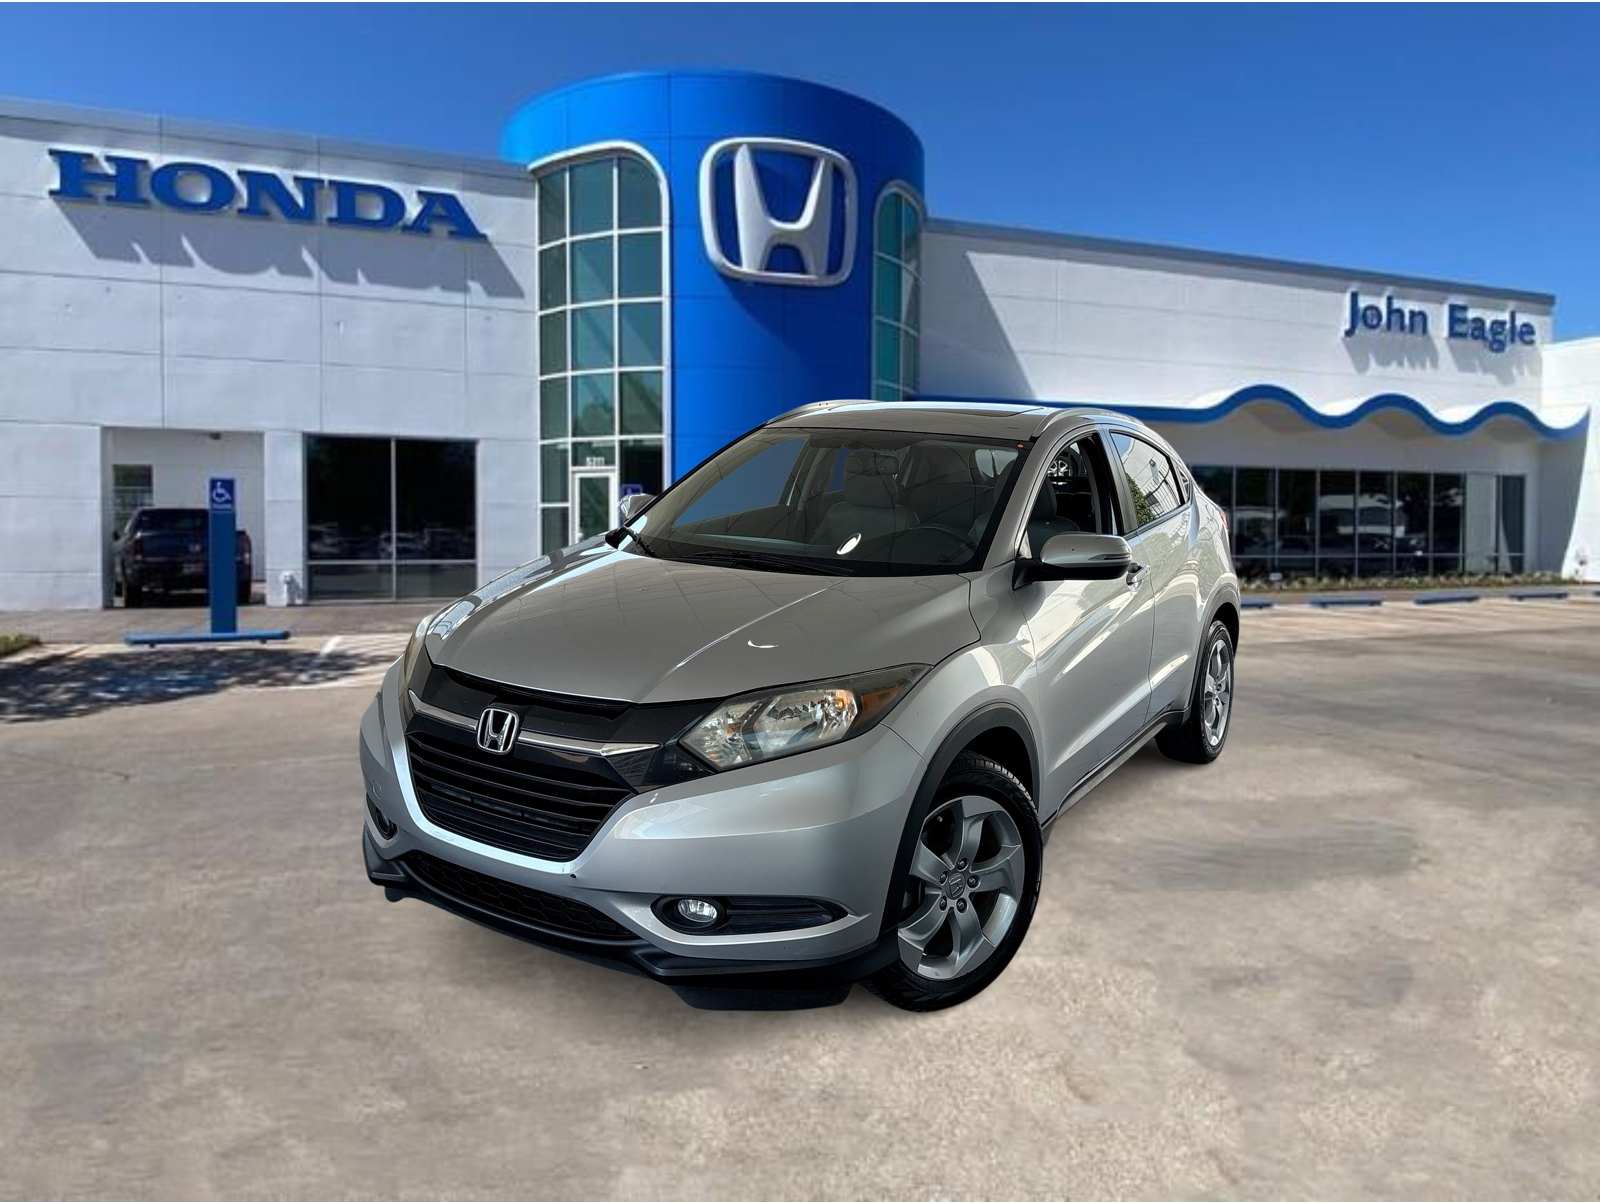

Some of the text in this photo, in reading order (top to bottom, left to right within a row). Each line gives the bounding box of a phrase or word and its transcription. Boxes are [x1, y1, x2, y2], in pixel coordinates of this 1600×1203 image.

[48, 148, 487, 240] HONDA
[1344, 291, 1536, 353] John Eagle
